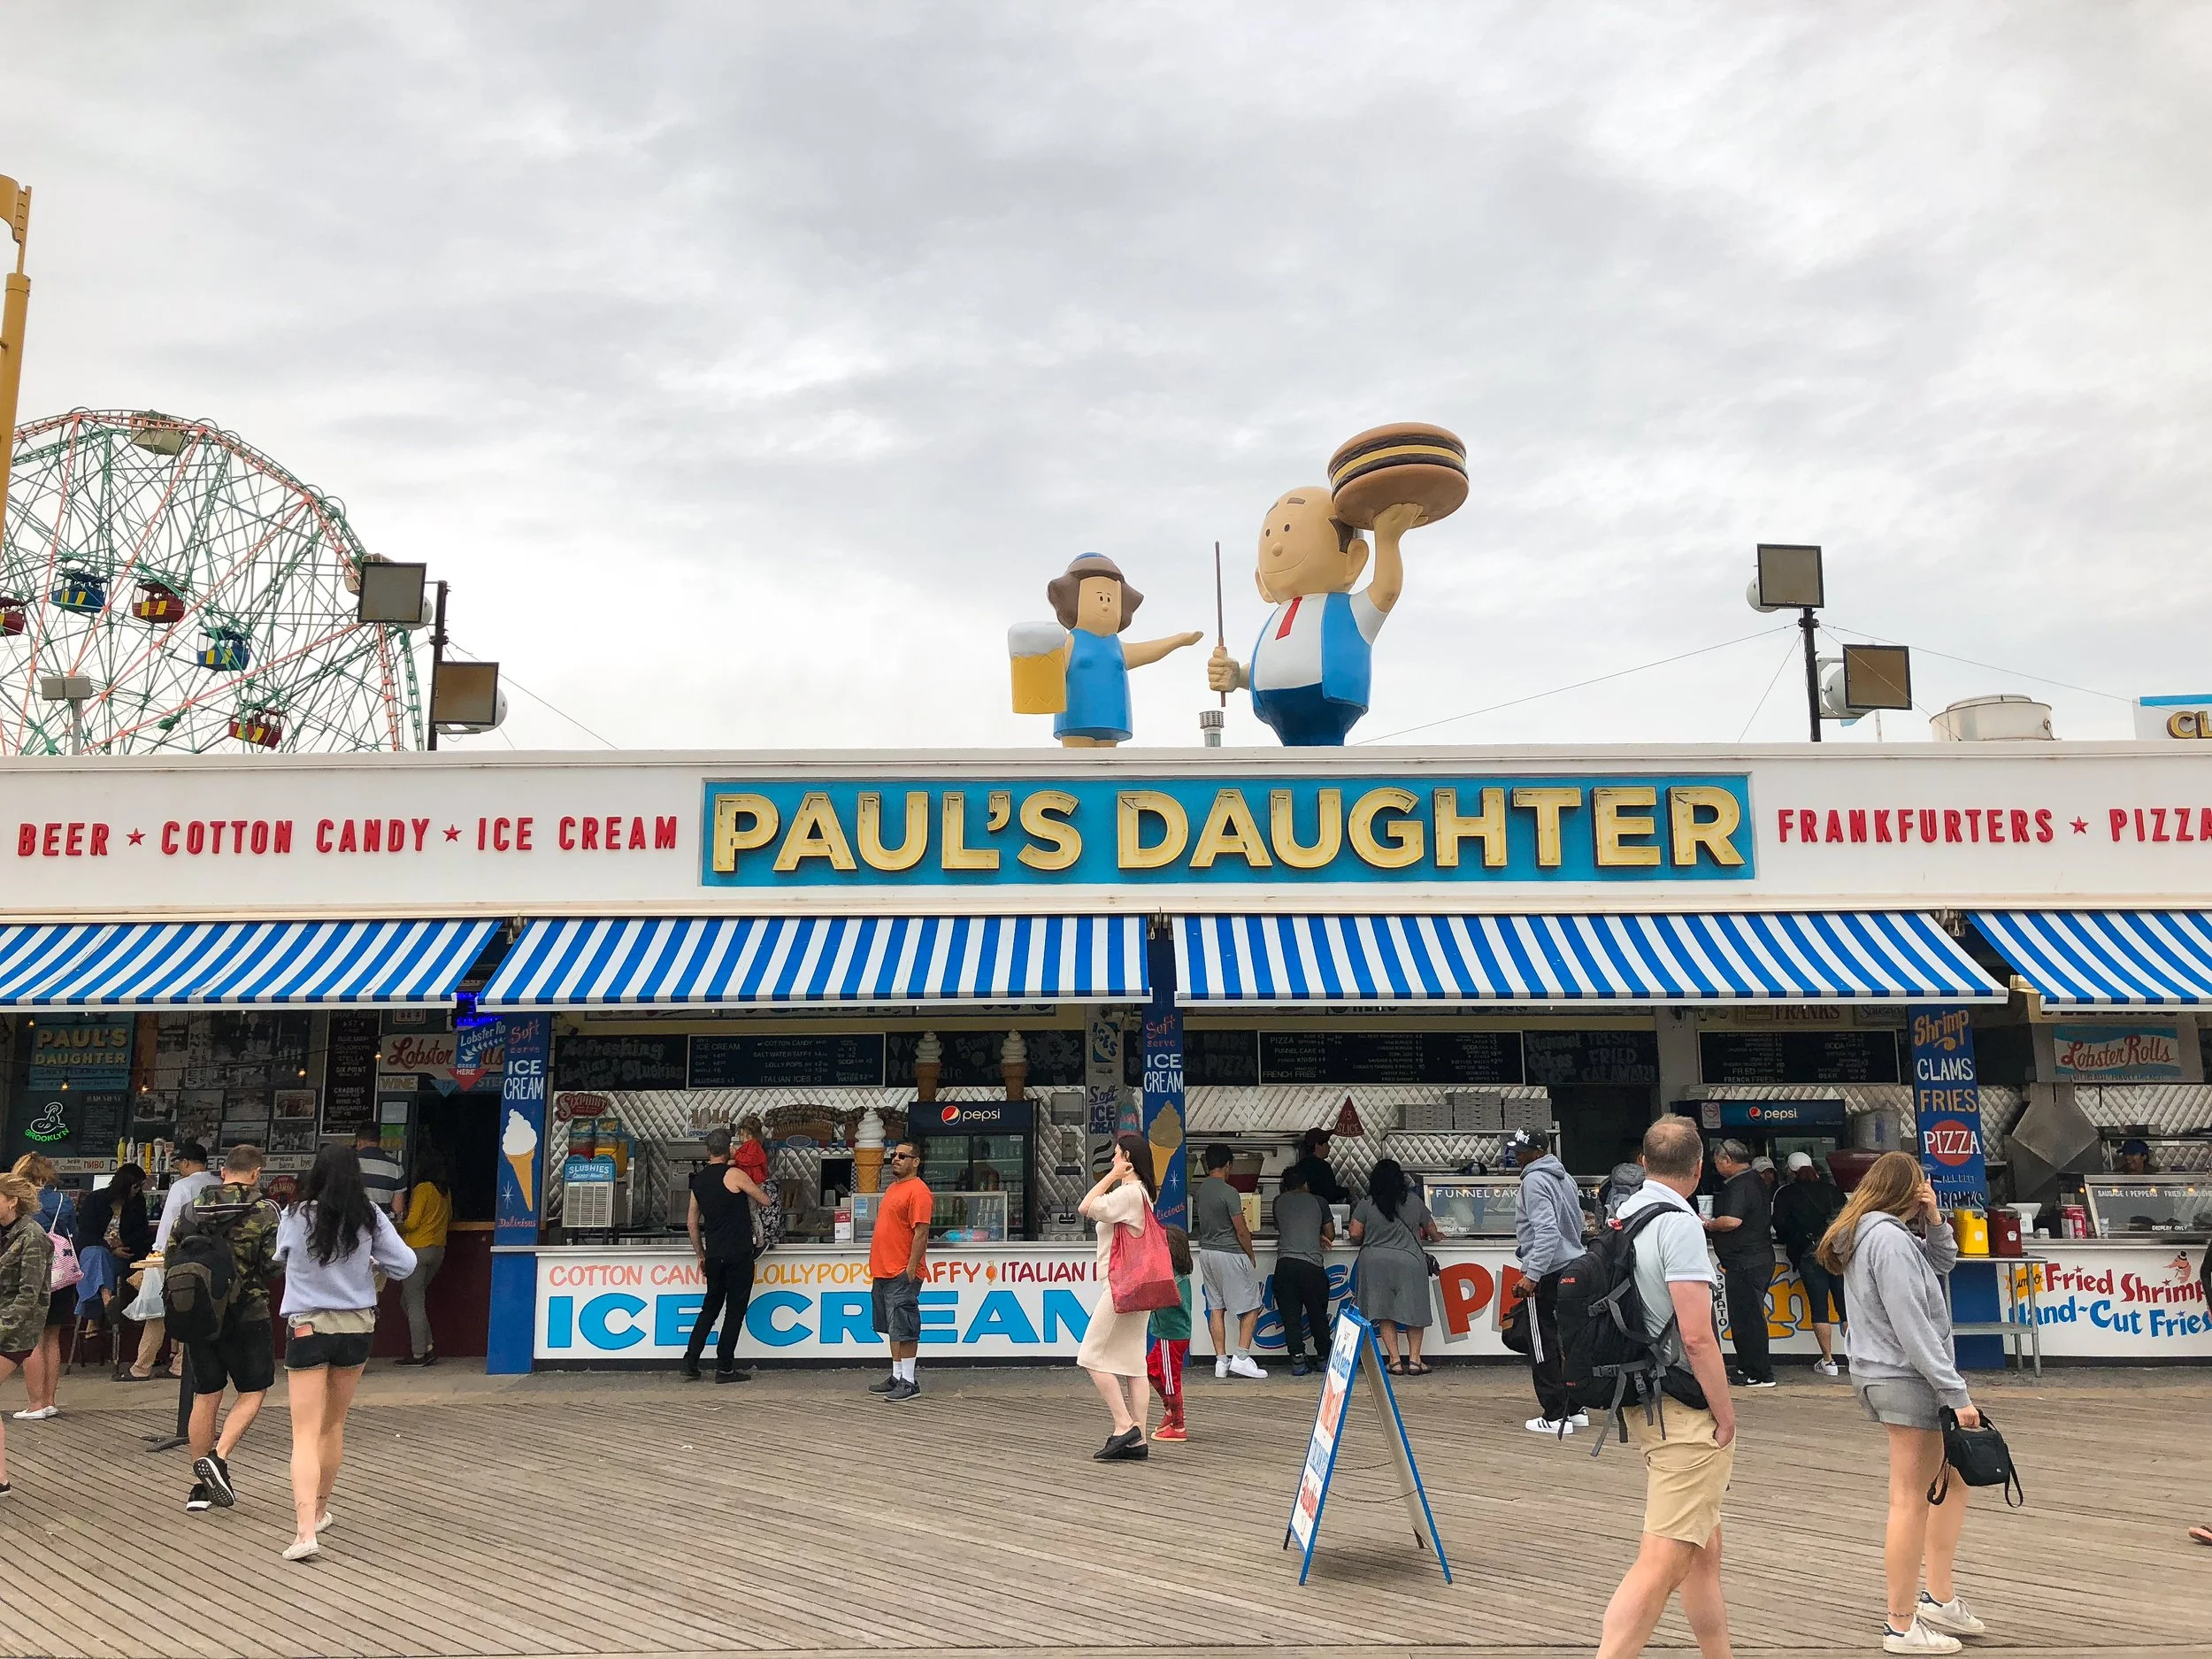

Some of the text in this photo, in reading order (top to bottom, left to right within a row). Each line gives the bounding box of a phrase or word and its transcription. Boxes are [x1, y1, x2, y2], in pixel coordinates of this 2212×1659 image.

[18, 815, 677, 856] BEER COTTON CANDY ICE CREAM
[712, 787, 1747, 872] PAUL'S DAUGHTER
[1778, 808, 2212, 843] FRANKFURTERS PIZZA
[461, 1026, 495, 1048] Lobster
[509, 1018, 541, 1044] Soft
[1146, 1013, 1176, 1039] Soft
[1914, 1009, 1970, 1047] Shrimp
[37, 1027, 127, 1049] PAUL'S
[1093, 1022, 1118, 1056] ICES
[34, 1053, 127, 1066] DAUGHTER
[387, 1037, 454, 1071] Lobster
[1147, 1053, 1182, 1069] ICE
[1588, 1047, 1638, 1064] FRIED
[2061, 1034, 2175, 1071] Lobster Rolls
[508, 1059, 541, 1076] ICE
[1916, 1057, 1974, 1081] CLAMS
[380, 1077, 416, 1089] WINE
[503, 1076, 544, 1101] CREAM
[1143, 1071, 1184, 1093] CREAM
[1089, 1085, 1118, 1104] Soft
[1920, 1088, 1978, 1113] FRIES
[557, 1094, 607, 1120] SIXPOINT
[962, 1108, 1001, 1122] pepsi
[1090, 1105, 1115, 1122] ICE
[1763, 1108, 1798, 1120] pepsi
[24, 1128, 71, 1143] BROOKLYN
[1336, 1123, 1362, 1134] SLICE
[1923, 1130, 1982, 1155] PIZZA
[569, 1164, 610, 1174] SLUSHIES
[1436, 1188, 1491, 1199] FUNNEL
[1494, 1188, 1517, 1199] CAK
[1586, 1188, 1598, 1200] $3
[498, 1215, 536, 1227] Delicious
[1156, 1202, 1187, 1220] licious
[549, 1265, 642, 1286] COTTON
[650, 1264, 706, 1286] CAN
[753, 1263, 874, 1285] LOLLYPOPS
[922, 1262, 981, 1283] AFFY
[1001, 1261, 1086, 1283] ITALIAN
[2045, 1263, 2115, 1296] Fried
[547, 1291, 719, 1350] ICE
[2149, 1309, 2212, 1338] Fries
